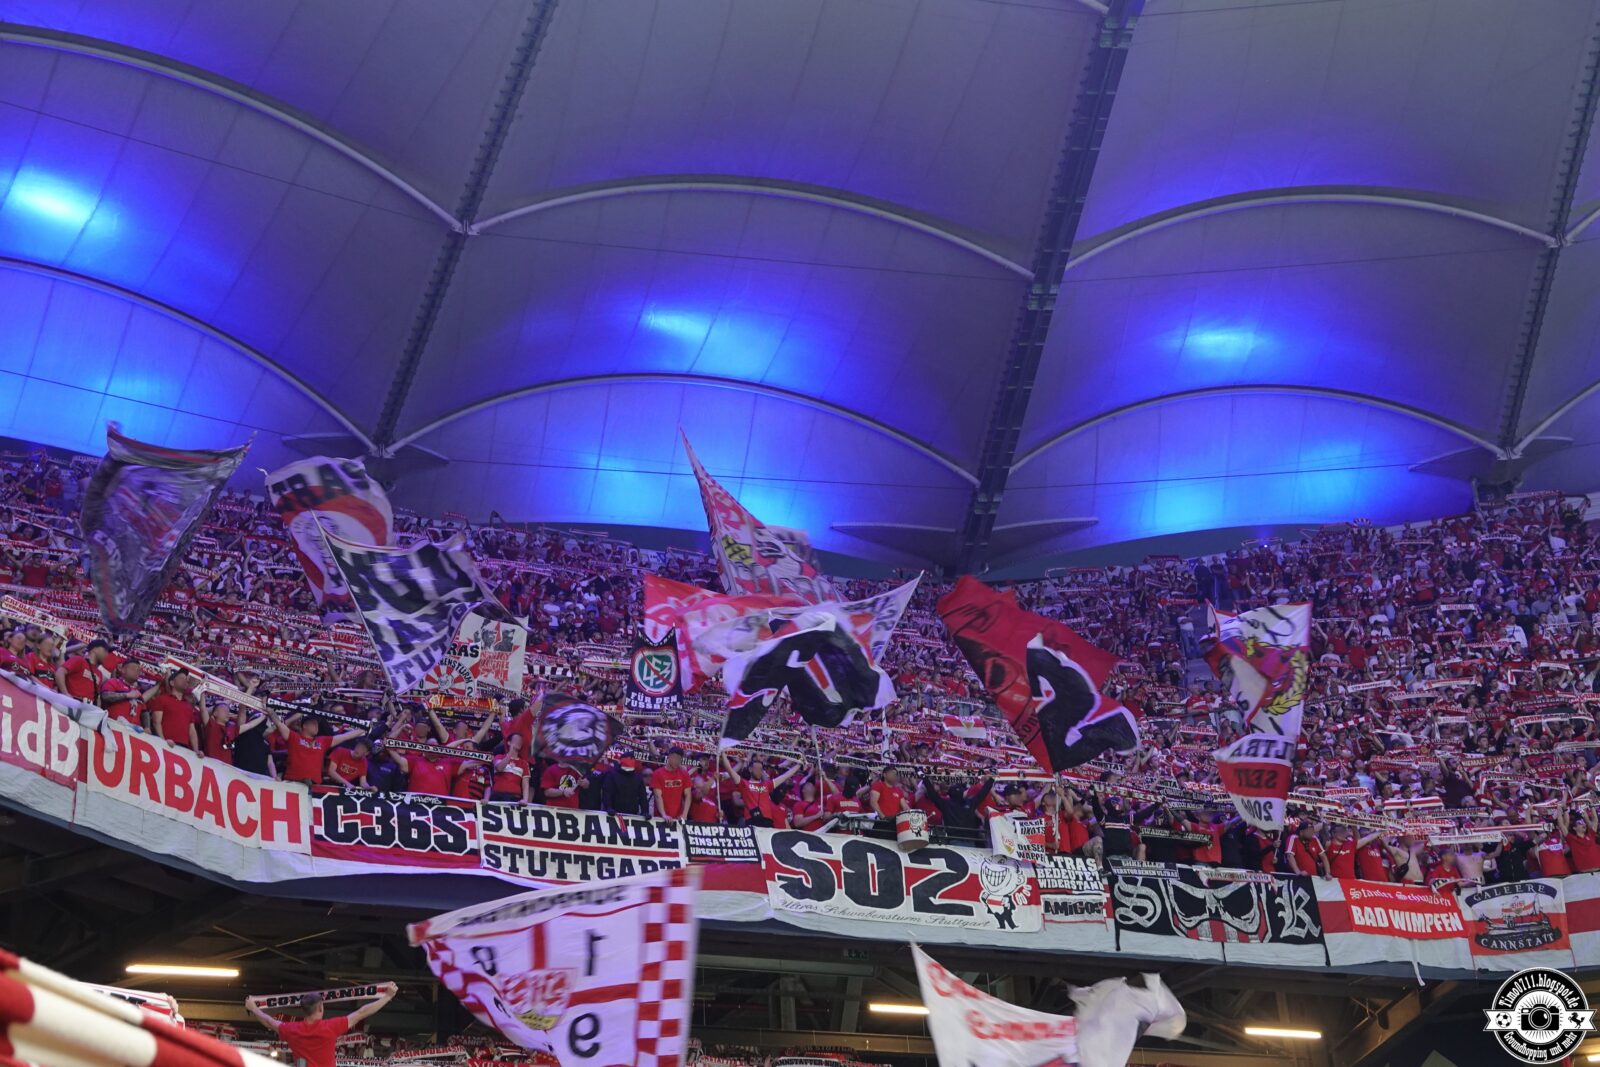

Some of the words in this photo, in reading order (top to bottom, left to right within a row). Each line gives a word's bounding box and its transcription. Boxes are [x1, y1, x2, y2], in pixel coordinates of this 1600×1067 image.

[631, 692, 652, 703] FÜR
[93, 728, 303, 845] URBACH
[482, 804, 680, 850] SÜDBANDE
[685, 825, 725, 837] KAMPF
[728, 827, 752, 838] UND
[688, 836, 733, 848] EINSATZ
[734, 837, 755, 848] FÜR
[690, 846, 722, 856] UNSERE
[1142, 861, 1166, 869] ALLEN
[1037, 867, 1101, 882] BEDEUTET
[1473, 883, 1546, 902] GALEERE
[924, 914, 992, 929] Stuttgart
[1350, 904, 1389, 928] BAD
[1388, 908, 1464, 934] WIMPFEN
